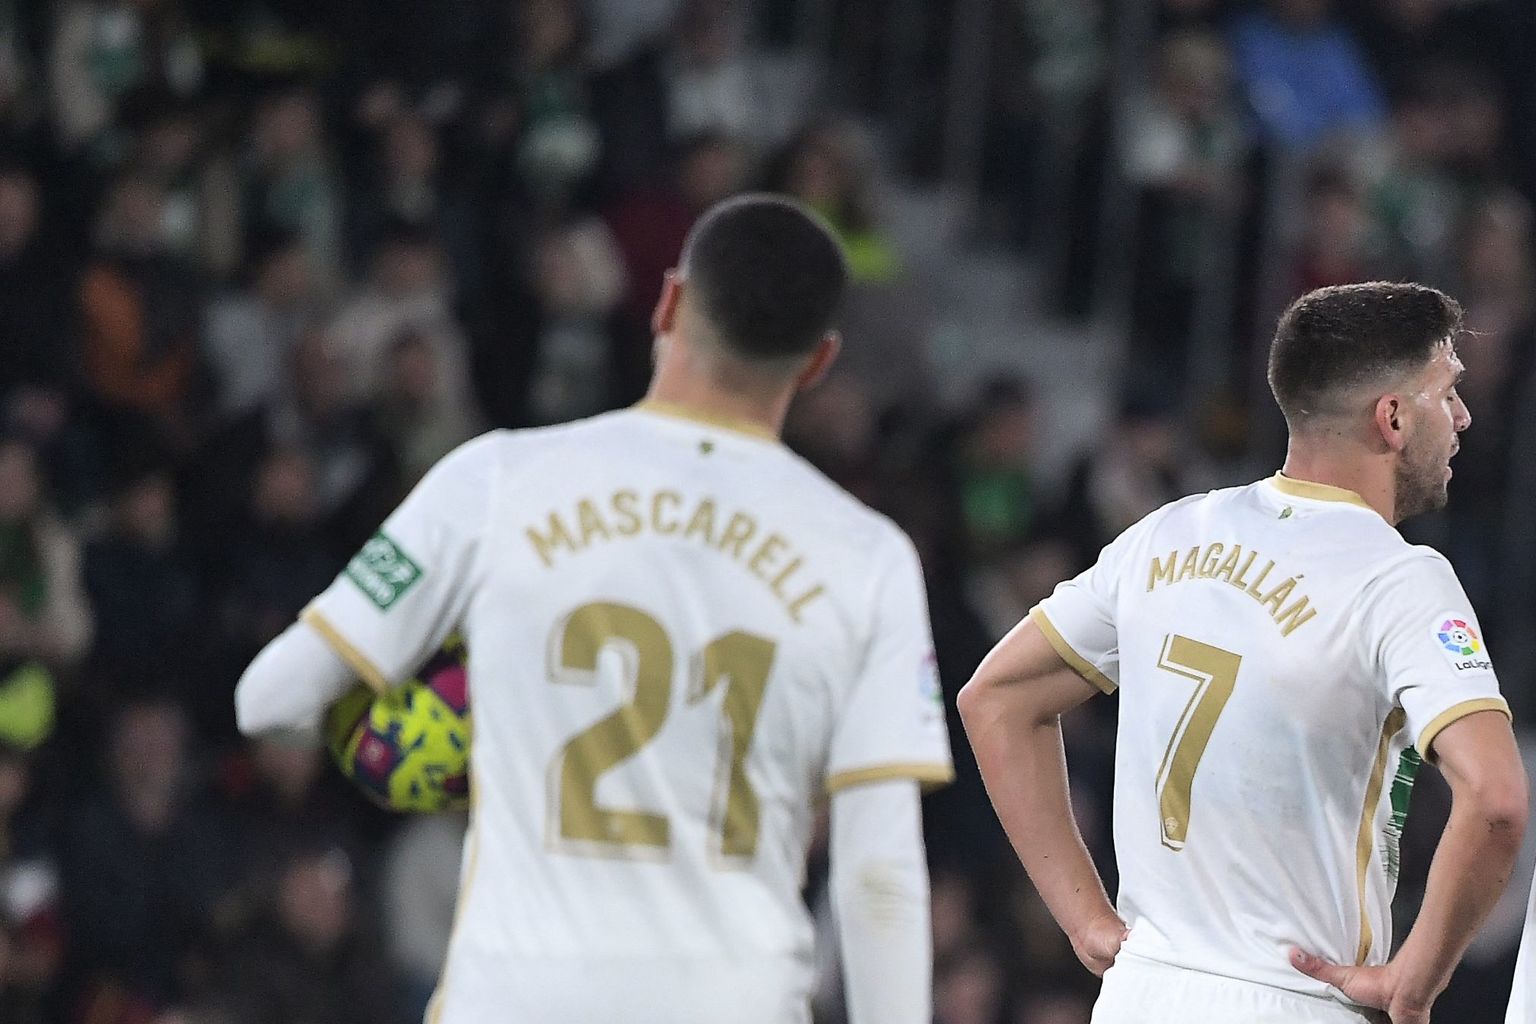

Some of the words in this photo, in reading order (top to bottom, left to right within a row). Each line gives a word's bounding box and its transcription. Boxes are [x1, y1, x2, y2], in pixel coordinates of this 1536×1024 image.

[523, 490, 828, 624] MASCARELL
[1146, 542, 1318, 638] MAGALLÁN
[549, 600, 777, 868] 21
[1155, 632, 1243, 853] 7
